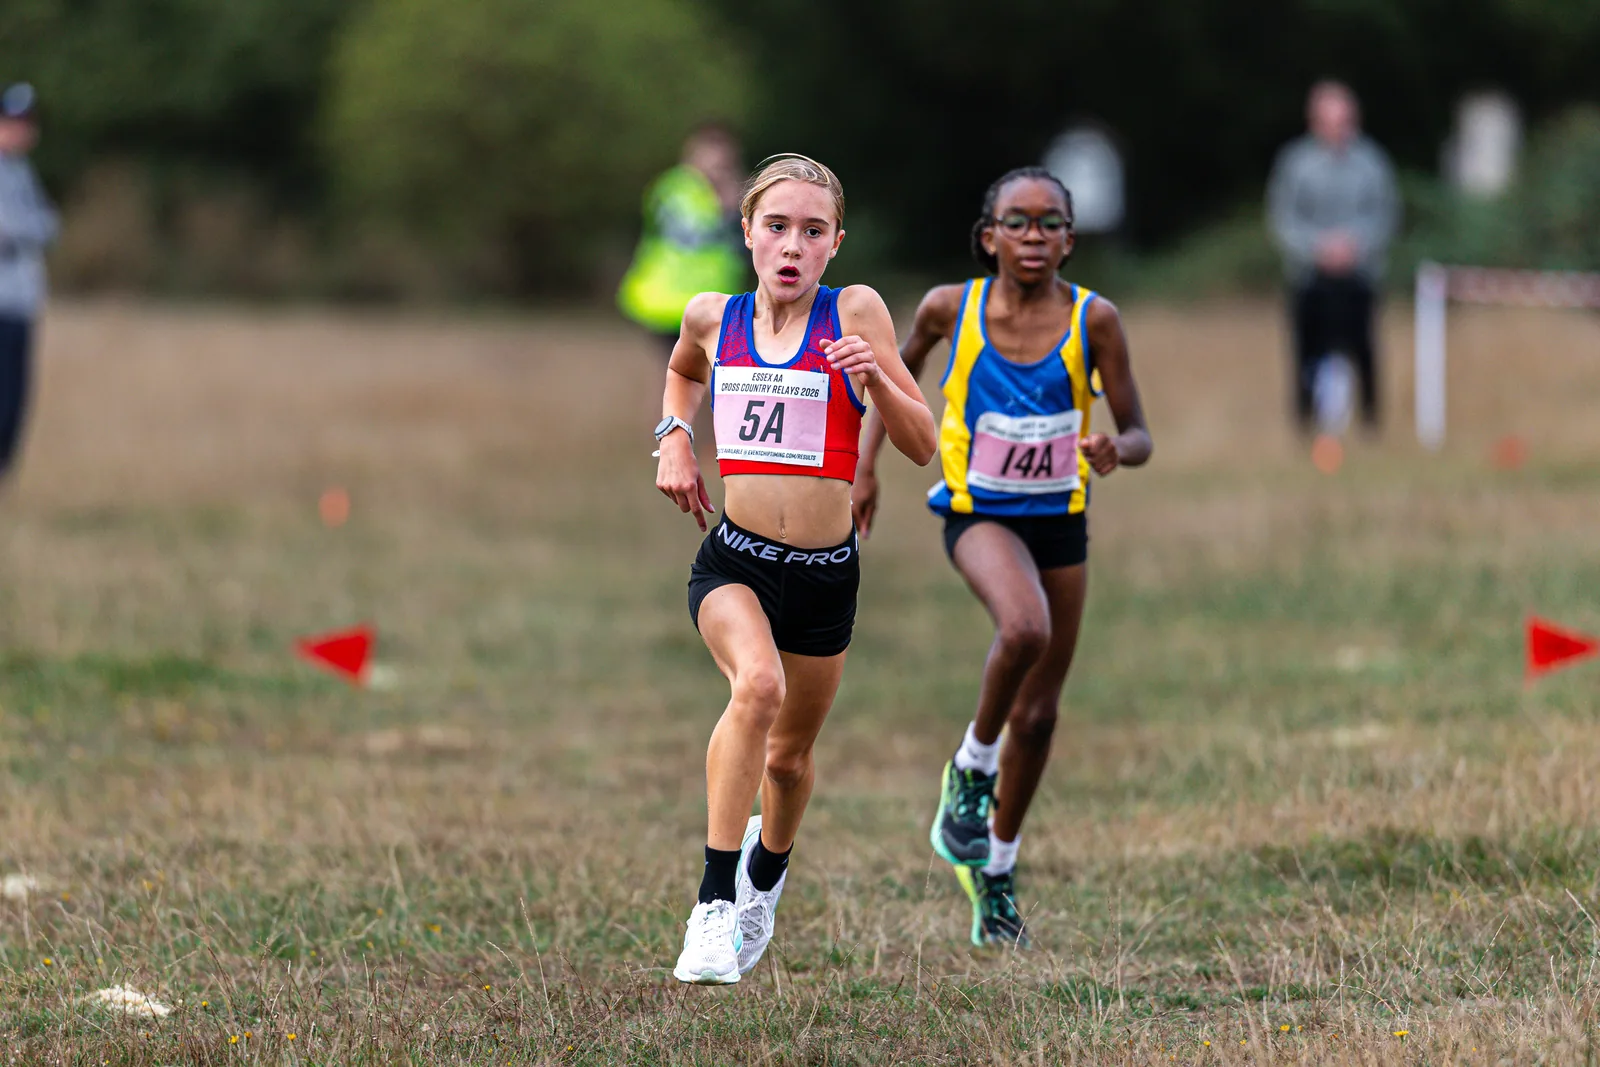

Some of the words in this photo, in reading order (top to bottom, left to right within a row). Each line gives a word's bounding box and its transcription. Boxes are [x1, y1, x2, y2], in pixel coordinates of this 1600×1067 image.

[721, 382, 741, 392] CROSS
[741, 383, 771, 393] COUNTRY
[772, 385, 800, 396] RELAYS
[800, 387, 820, 398] 2026
[752, 372, 773, 382] ESSEX
[773, 374, 783, 382] AA
[739, 400, 785, 444] 5A
[1001, 442, 1053, 477] 14A
[717, 522, 784, 561] NIKE
[784, 546, 851, 565] PRO
